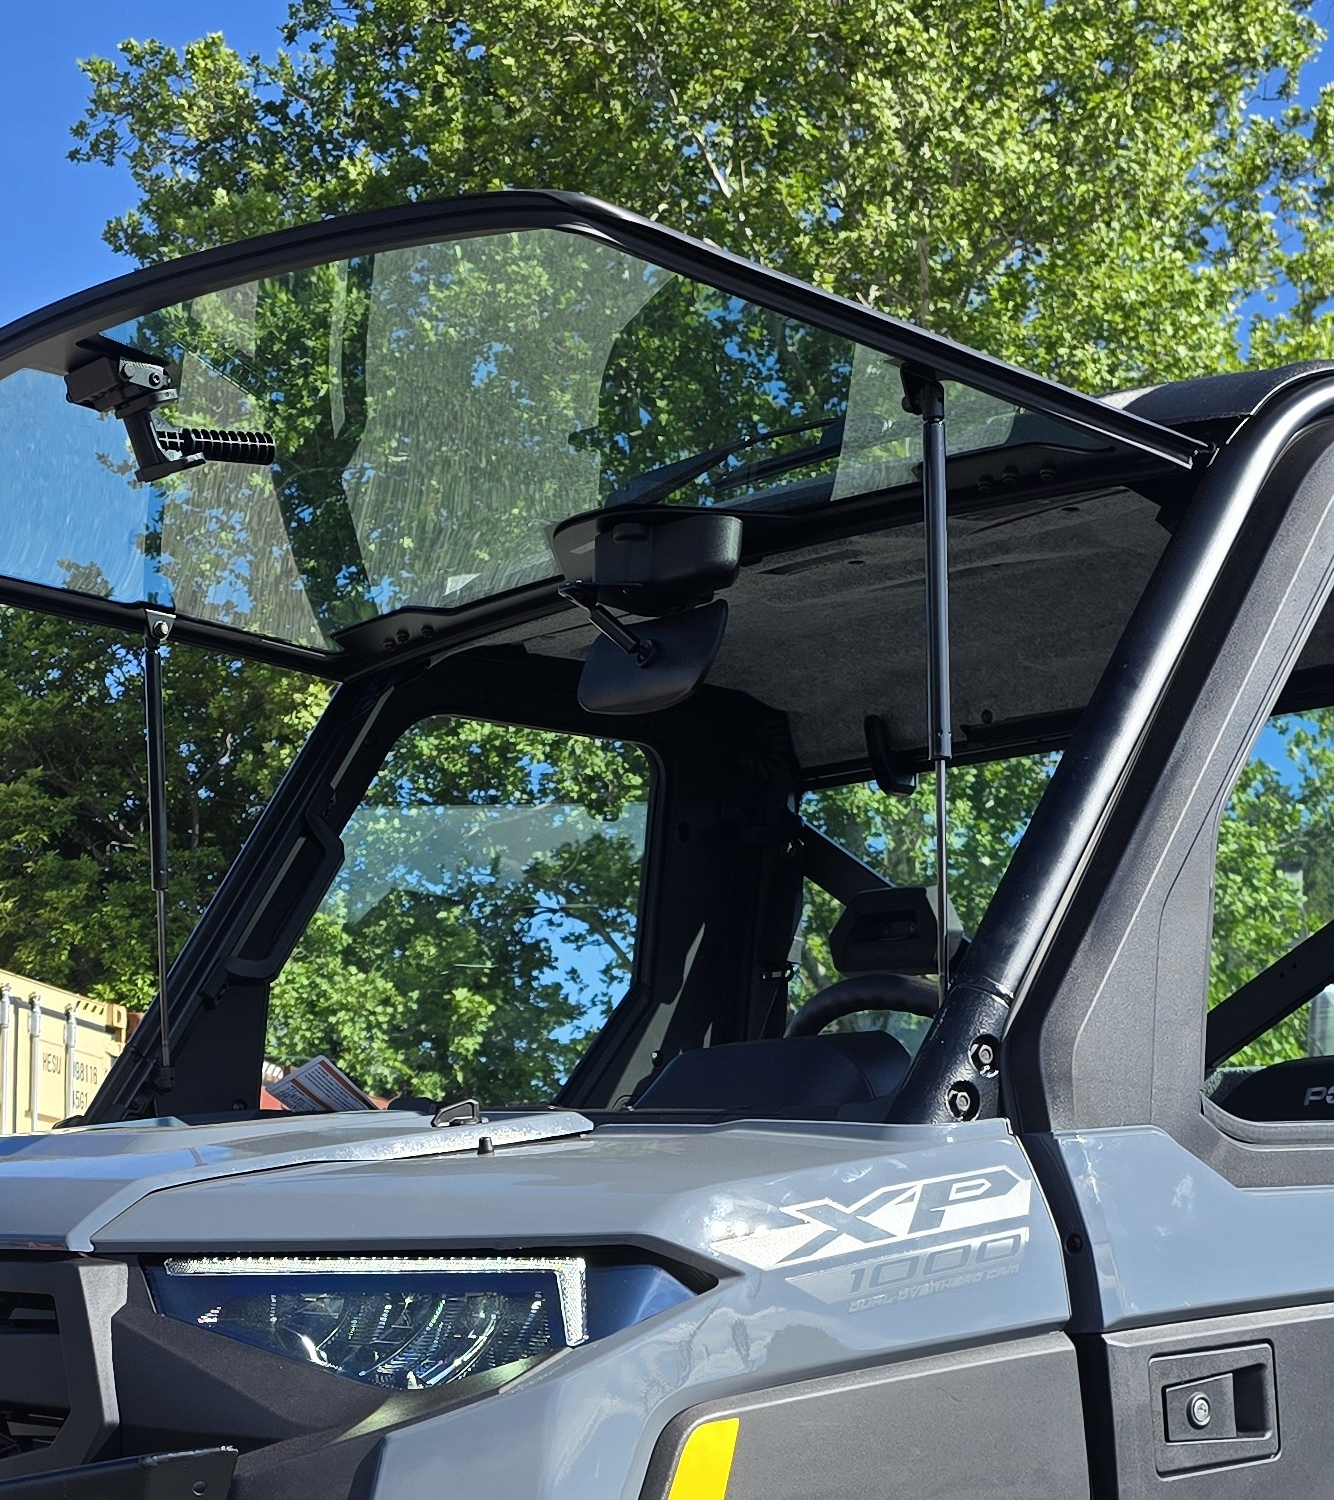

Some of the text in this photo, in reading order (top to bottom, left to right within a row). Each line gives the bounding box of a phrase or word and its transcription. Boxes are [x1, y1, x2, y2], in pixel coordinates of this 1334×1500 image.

[73, 1061, 98, 1085] 98116
[73, 1090, 88, 1110] 5G1
[771, 1166, 1022, 1265] XP
[850, 1233, 1022, 1293] 1000
